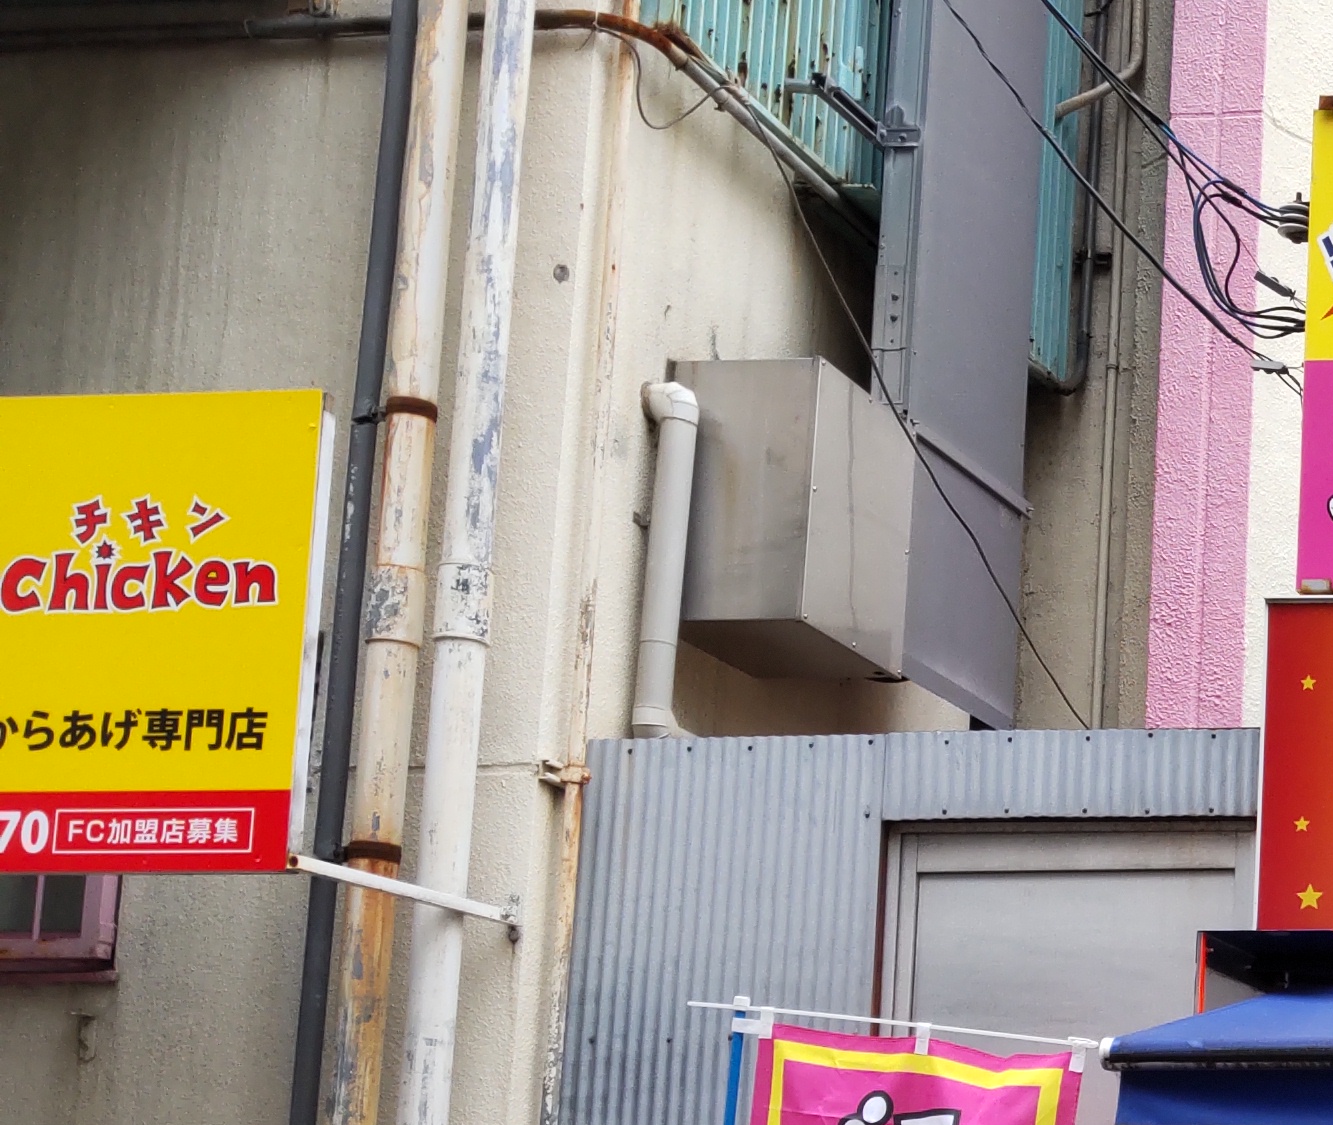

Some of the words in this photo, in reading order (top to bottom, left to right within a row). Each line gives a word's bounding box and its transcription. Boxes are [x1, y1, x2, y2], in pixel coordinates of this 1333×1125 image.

[73, 494, 229, 544] チキン
[2, 543, 278, 613] Chicken
[67, 819, 238, 844] FC加盟店募集
